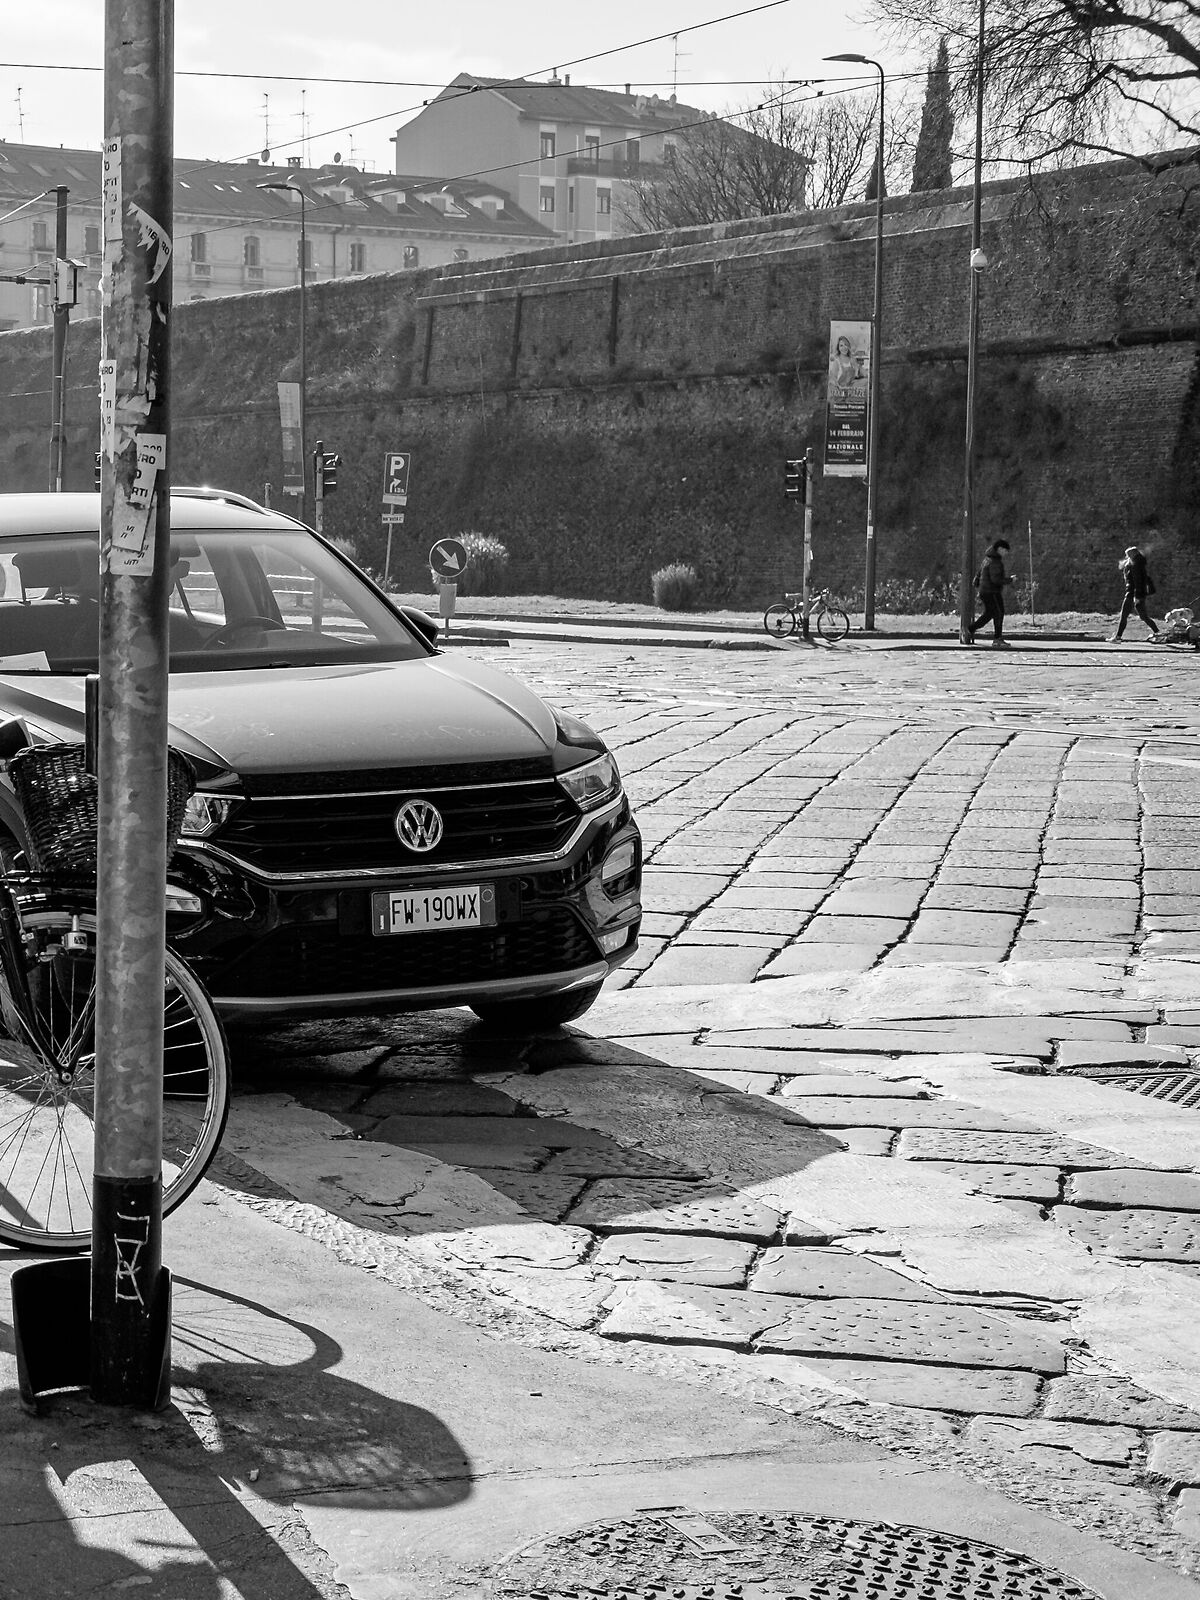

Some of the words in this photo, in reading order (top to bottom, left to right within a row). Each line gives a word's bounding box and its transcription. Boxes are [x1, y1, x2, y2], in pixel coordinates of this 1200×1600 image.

[390, 456, 405, 476] P
[392, 898, 414, 925] FW
[423, 893, 478, 922] 190WX
